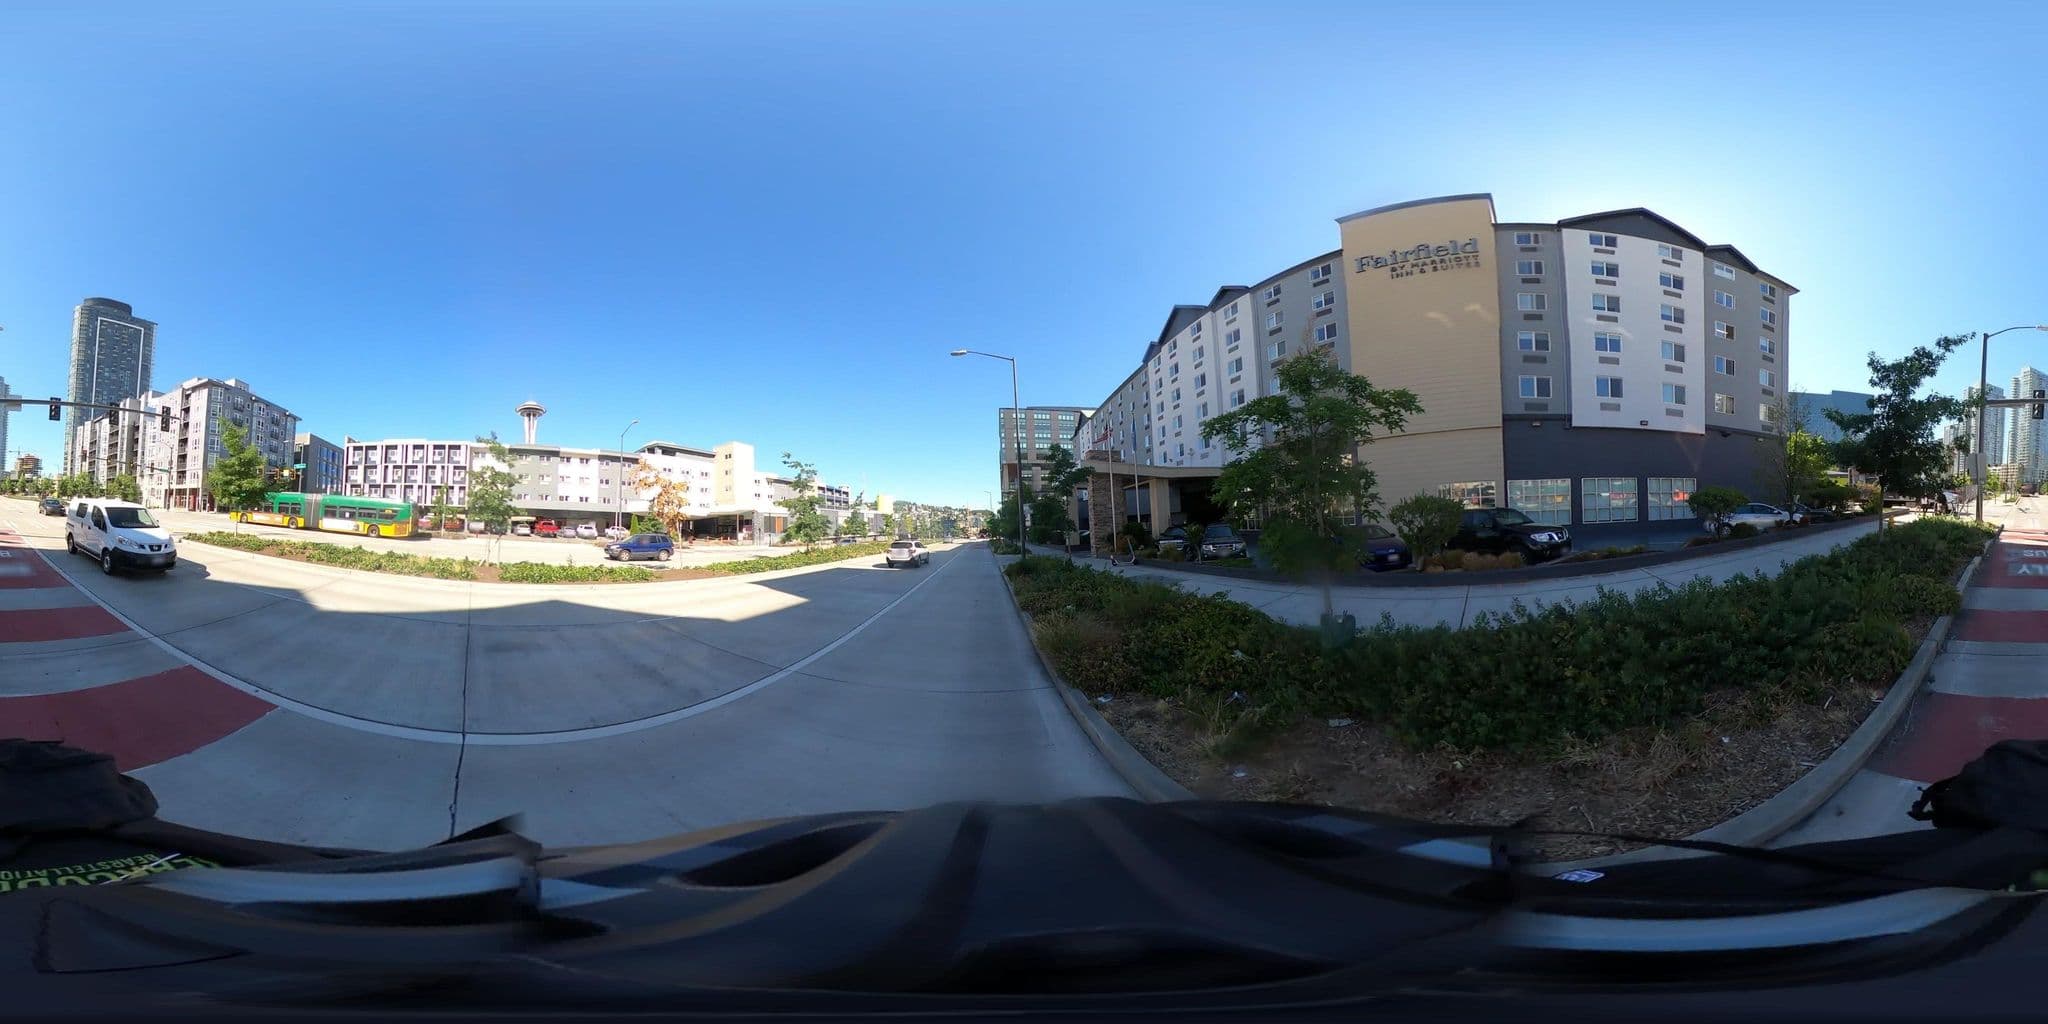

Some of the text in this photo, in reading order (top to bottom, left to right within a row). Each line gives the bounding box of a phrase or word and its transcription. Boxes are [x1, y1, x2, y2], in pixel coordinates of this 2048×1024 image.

[1355, 238, 1480, 274] Fairfield
[1390, 254, 1480, 273] BY MARRIOTT
[1391, 270, 1414, 280] INN
[1432, 262, 1481, 273] SUITES
